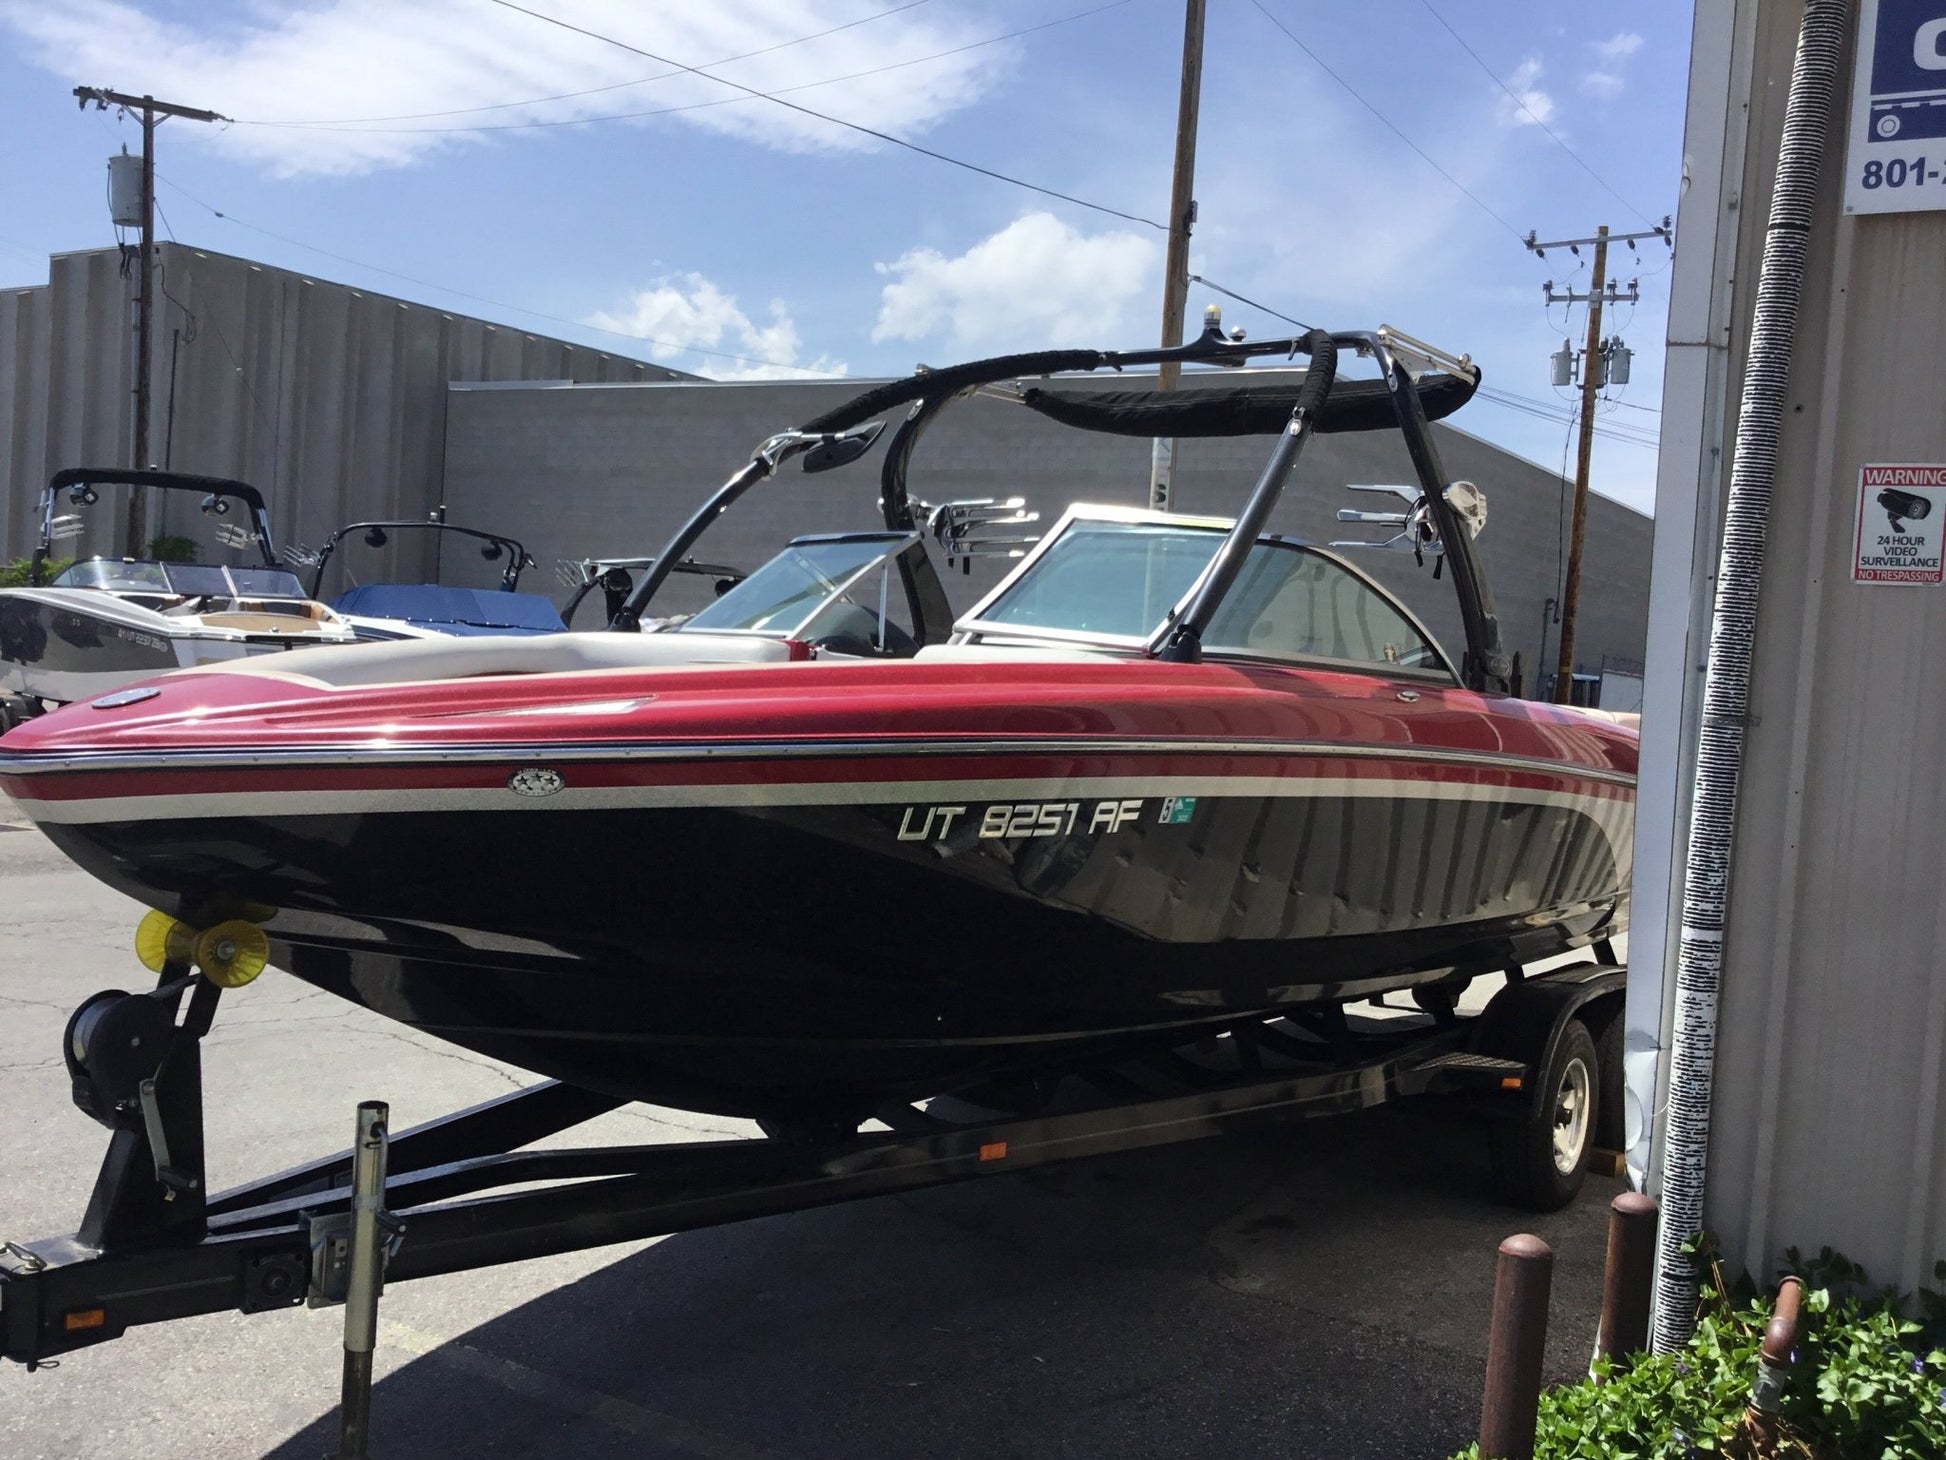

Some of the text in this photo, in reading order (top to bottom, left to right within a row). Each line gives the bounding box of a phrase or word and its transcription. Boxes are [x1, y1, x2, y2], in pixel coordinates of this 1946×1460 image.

[1862, 157, 1946, 190] 801-
[1865, 469, 1946, 486] WARNING
[1877, 536, 1925, 546] 24 HOUR
[1883, 546, 1918, 556] VIDEO
[1860, 556, 1939, 568] SURVEILLANCE
[1858, 570, 1940, 582] NO TRESPASSING
[897, 806, 967, 841] UT
[978, 802, 1080, 838] 8251
[1088, 800, 1144, 834] AF
